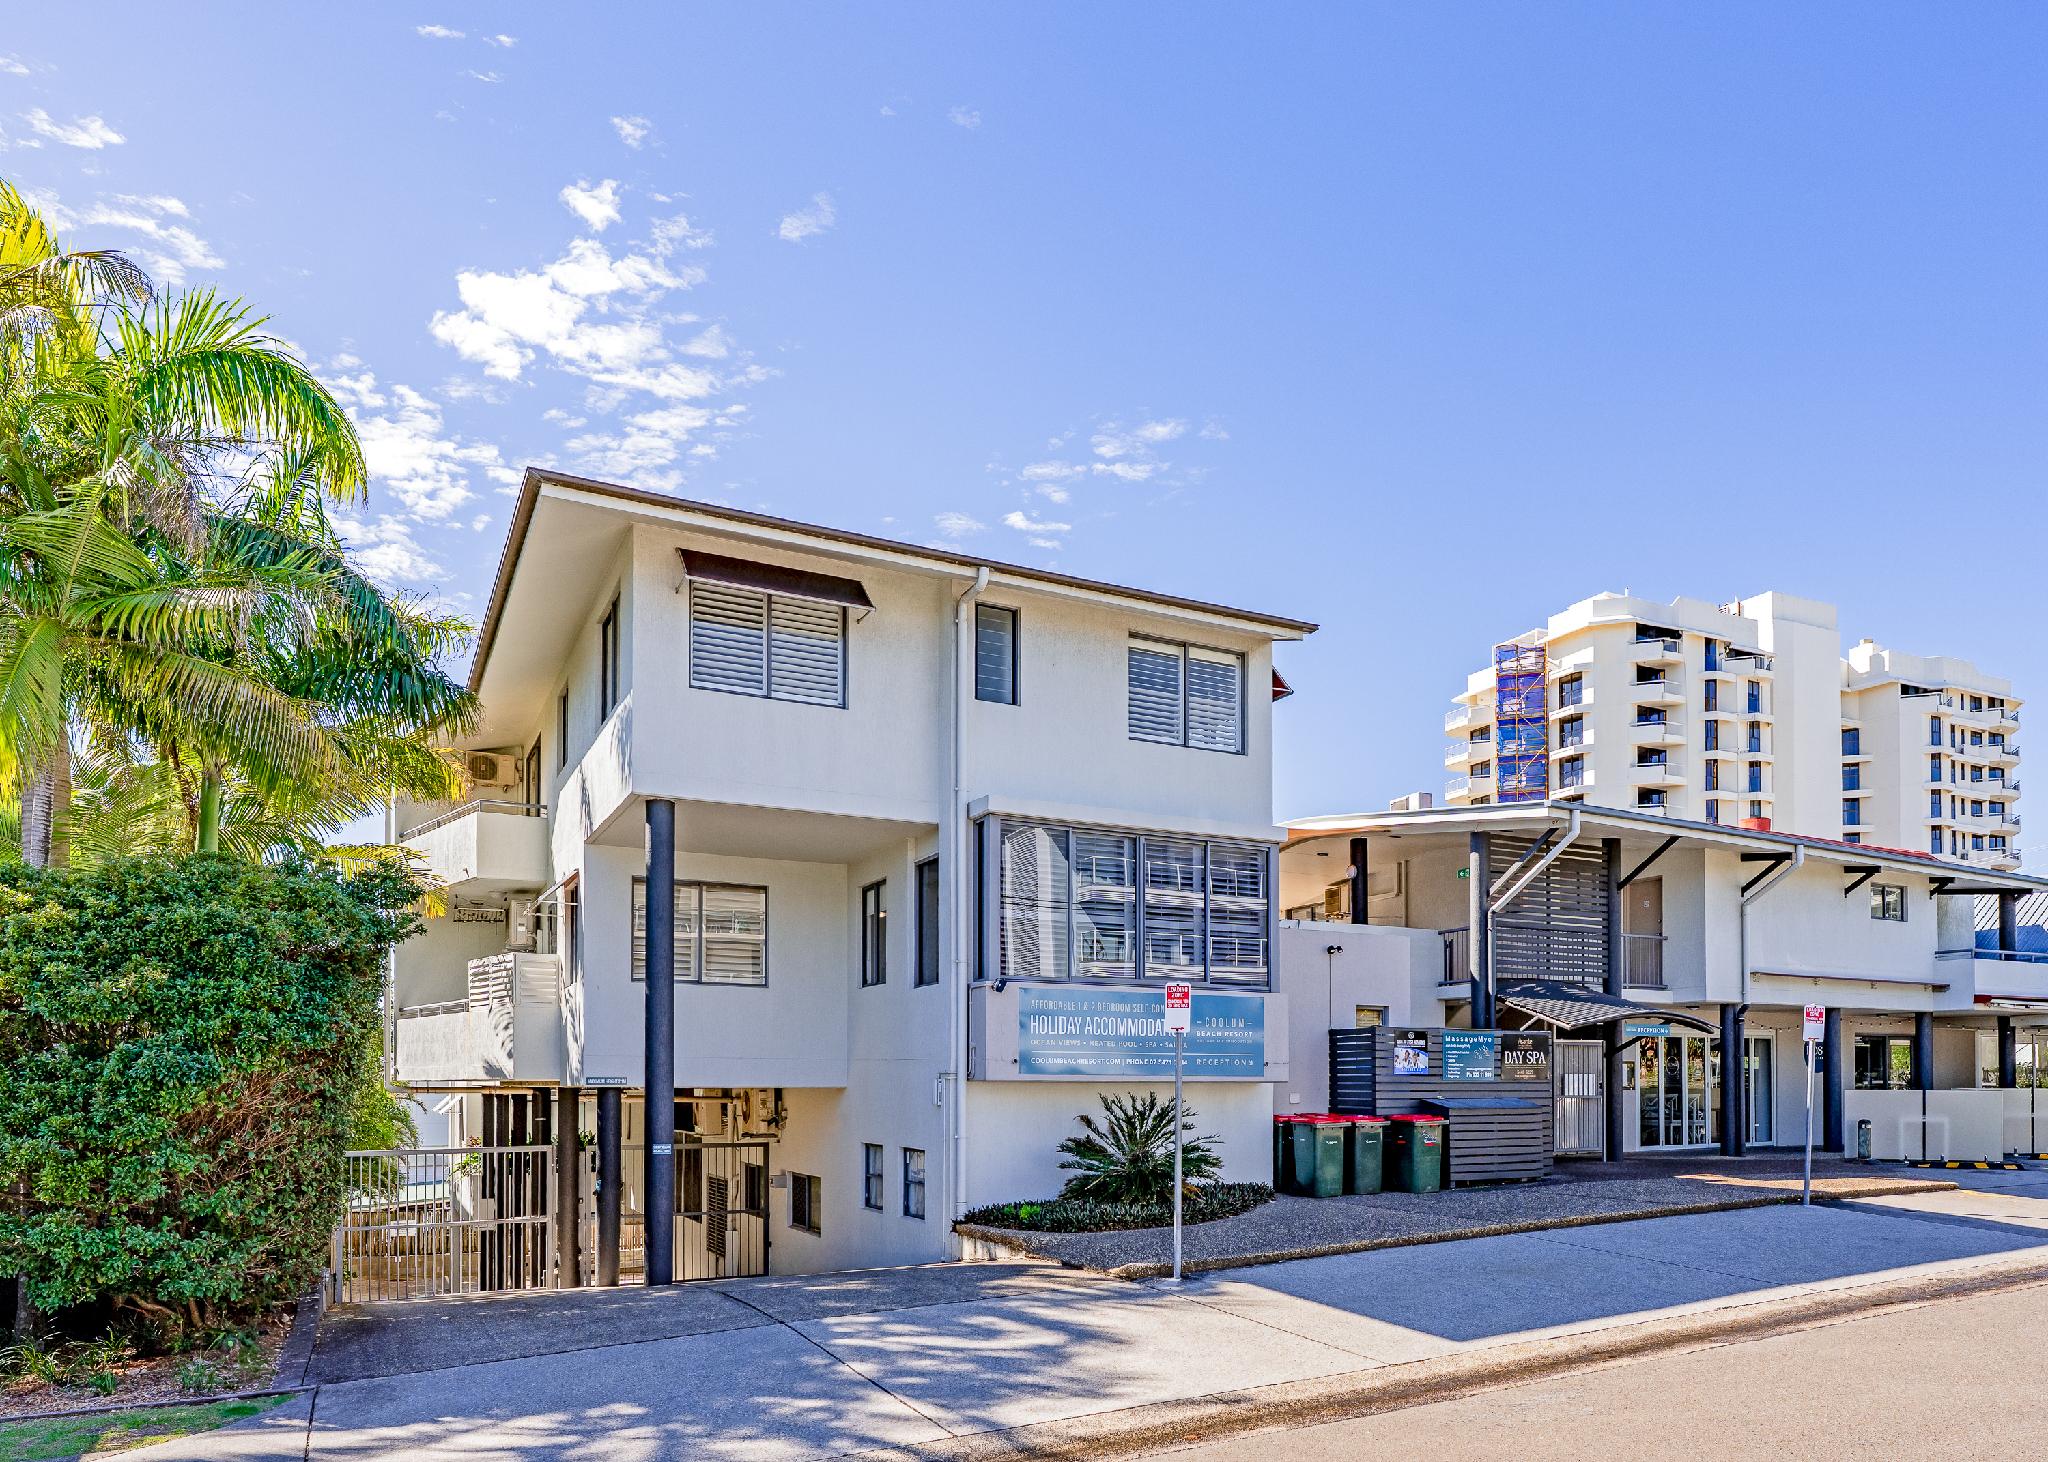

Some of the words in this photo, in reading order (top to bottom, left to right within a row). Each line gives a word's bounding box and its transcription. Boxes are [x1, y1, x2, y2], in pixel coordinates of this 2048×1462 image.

[1031, 999, 1075, 1011] AFFORDABLE
[1097, 1001, 1130, 1013] BEDROOM
[1030, 1014, 1082, 1035] HOLIDAY
[1085, 1016, 1187, 1037] ACCOMMODAT
[1205, 1017, 1245, 1028] COOLUM
[1030, 1039, 1056, 1047] OCEAN
[1058, 1039, 1080, 1047] VIEWS
[1196, 1058, 1247, 1066] RECEPTION
[1504, 1050, 1524, 1064] DAY
[1526, 1050, 1546, 1064] SPA
